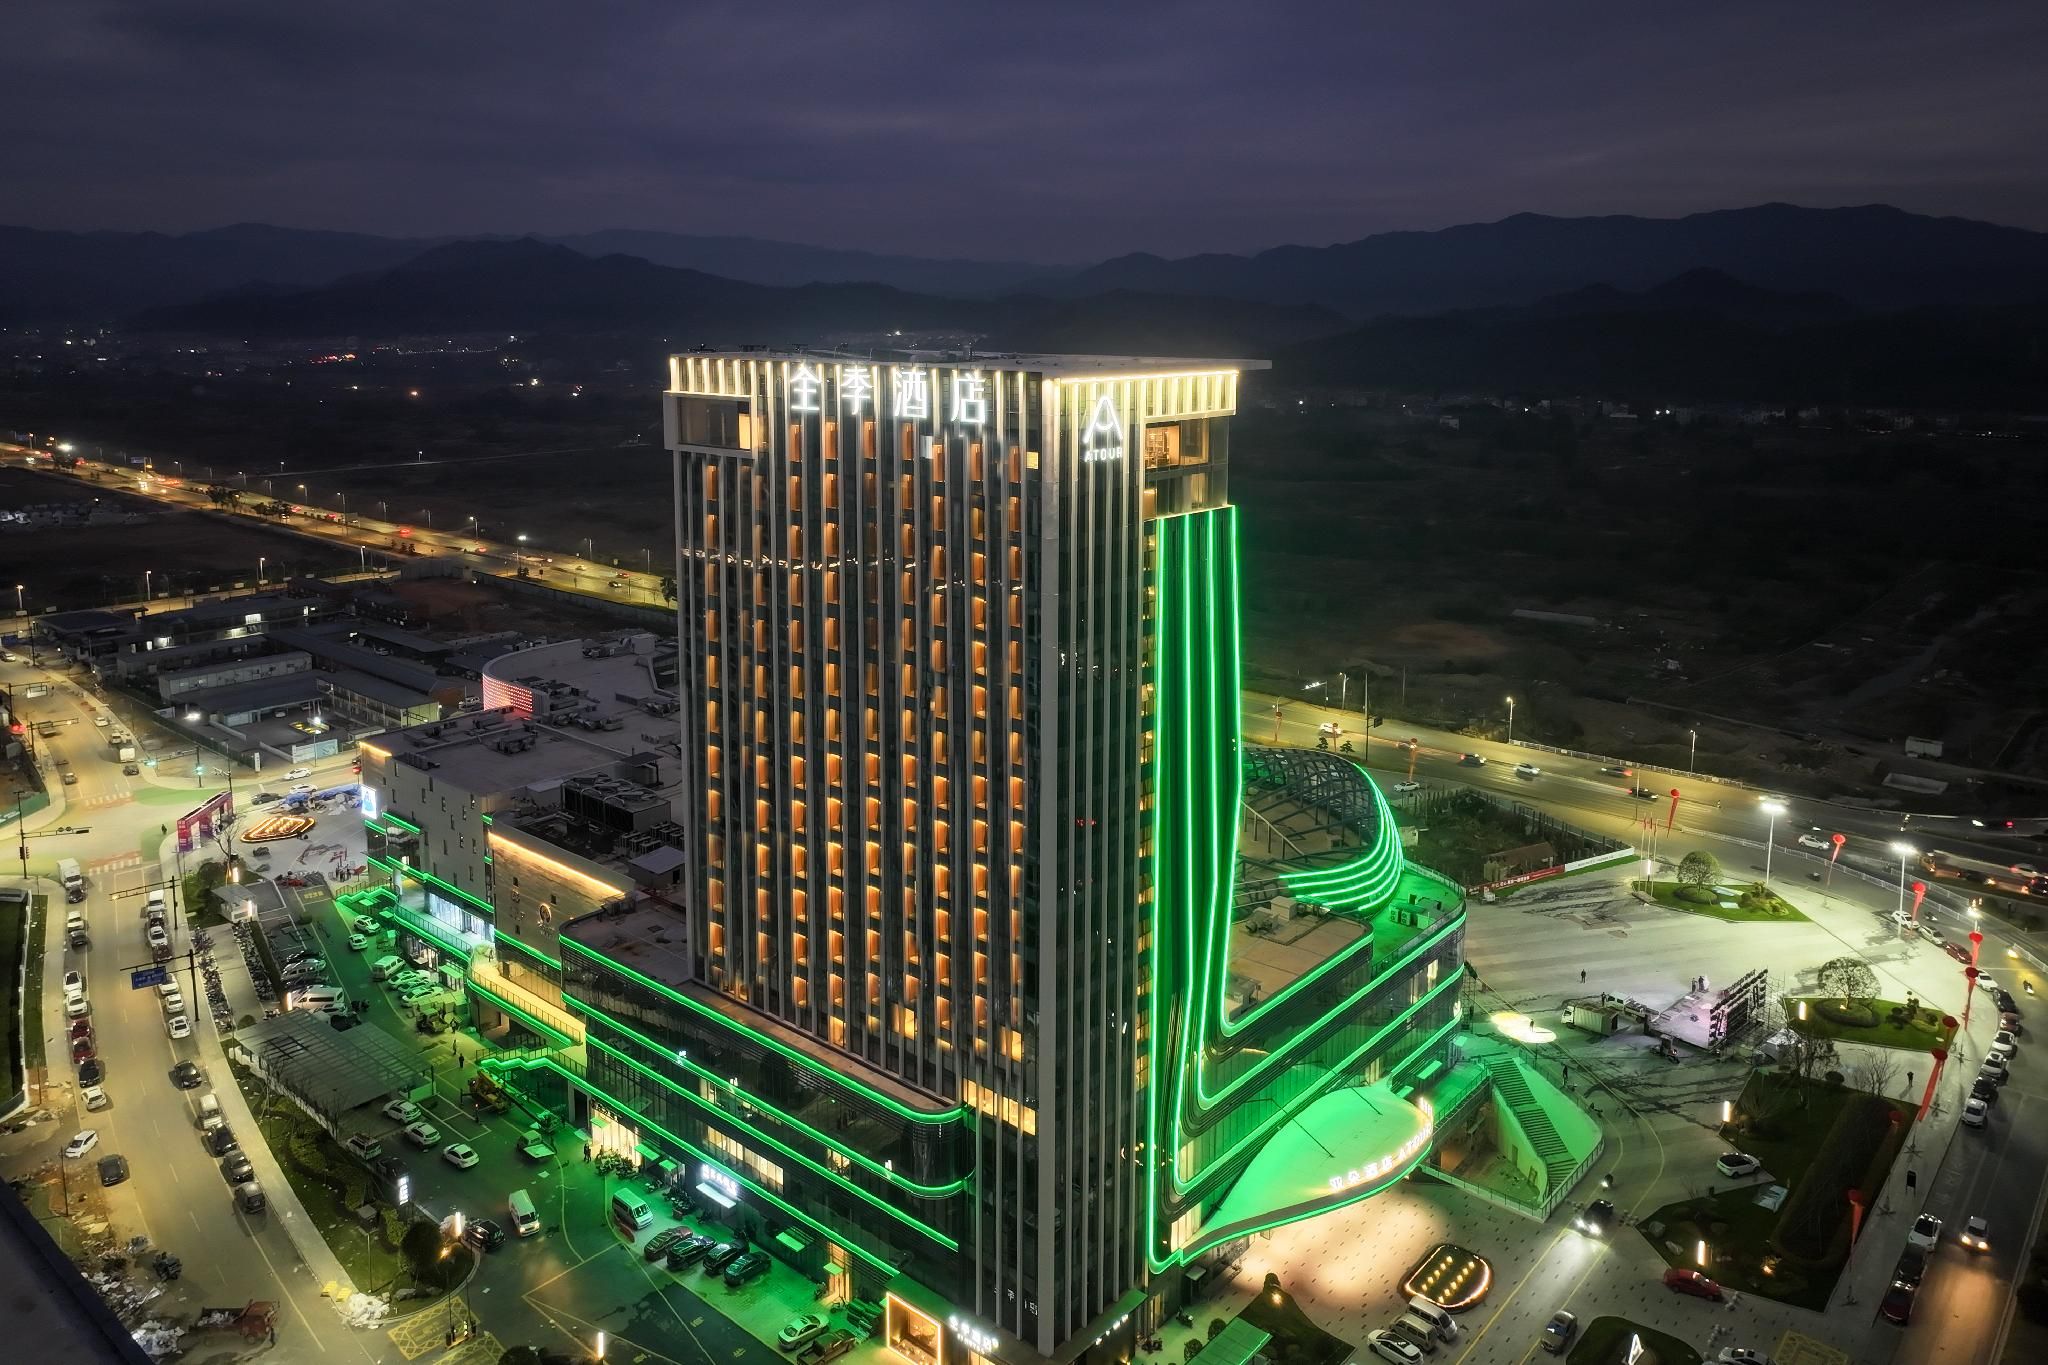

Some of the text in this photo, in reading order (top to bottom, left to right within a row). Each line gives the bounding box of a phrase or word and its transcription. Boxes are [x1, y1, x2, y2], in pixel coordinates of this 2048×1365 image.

[790, 364, 986, 424] 全季酒店
[1084, 446, 1123, 463] ATOUR
